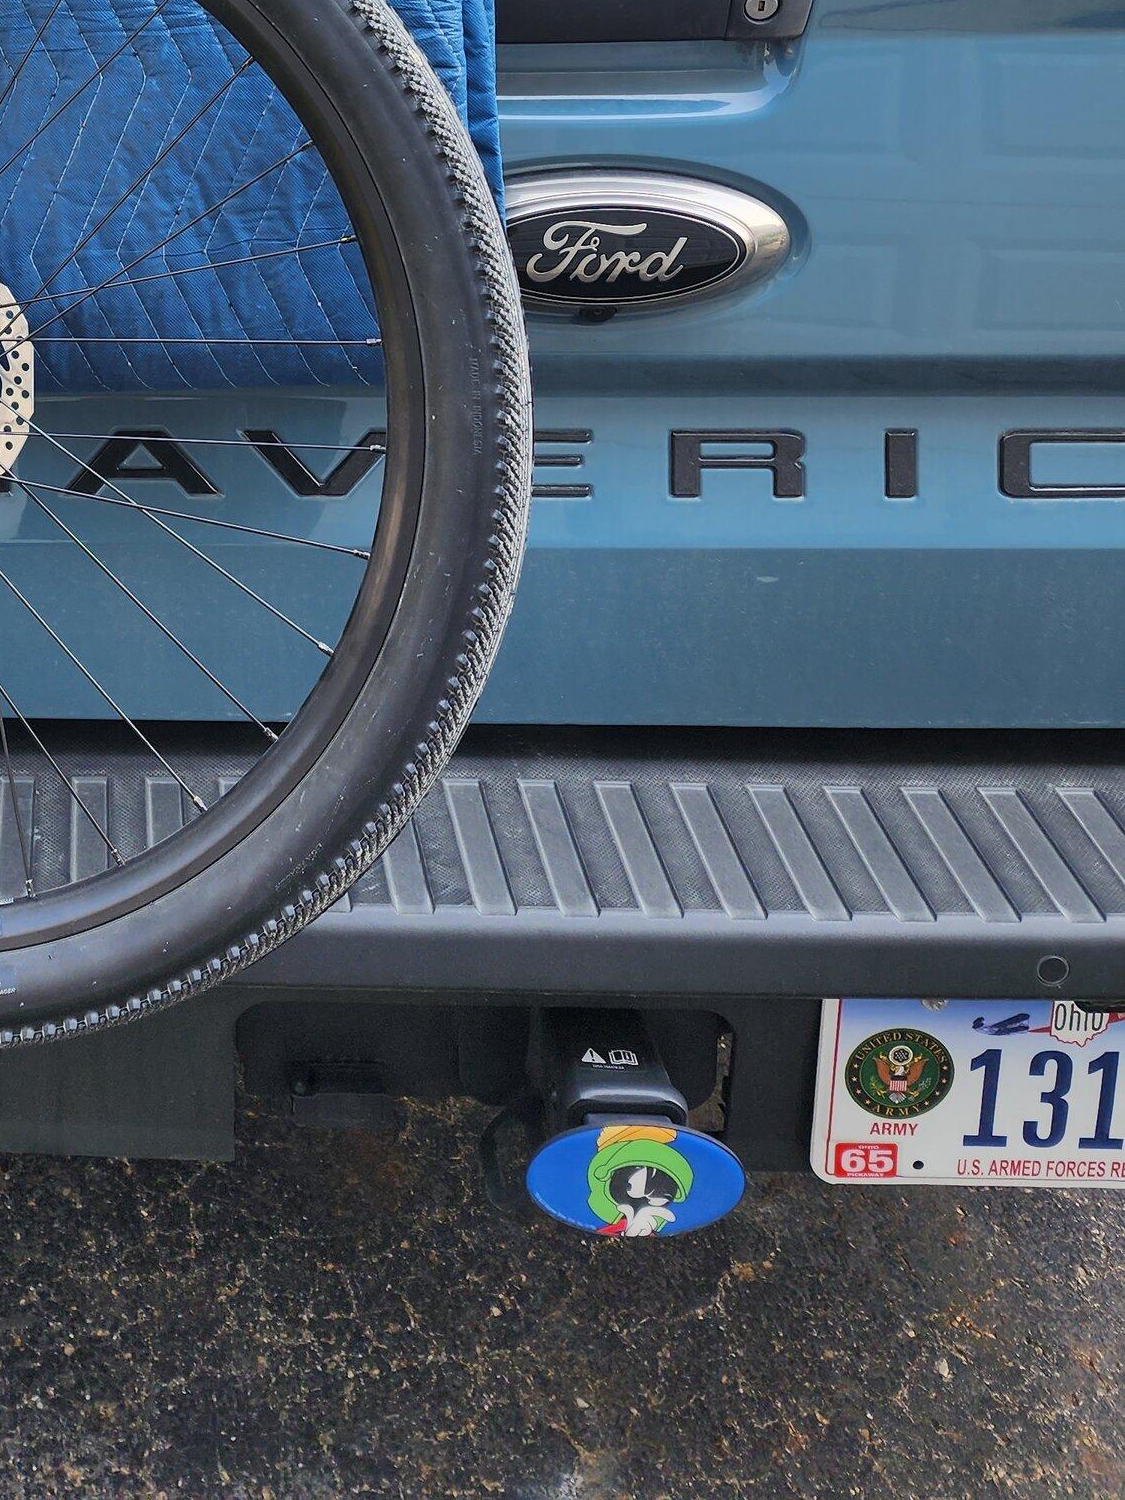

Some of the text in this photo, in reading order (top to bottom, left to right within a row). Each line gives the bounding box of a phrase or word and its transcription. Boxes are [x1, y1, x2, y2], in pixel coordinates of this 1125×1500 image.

[526, 220, 689, 284] Ford
[856, 1032, 948, 1063] UNITED STATES
[873, 1104, 921, 1116] ARMY
[963, 1048, 1124, 1150] 131
[870, 1122, 918, 1136] ARMY
[841, 1149, 894, 1173] 65
[957, 1159, 984, 1176] U.S.
[988, 1160, 1042, 1177] ARMED
[1046, 1161, 1106, 1178] FORCES
